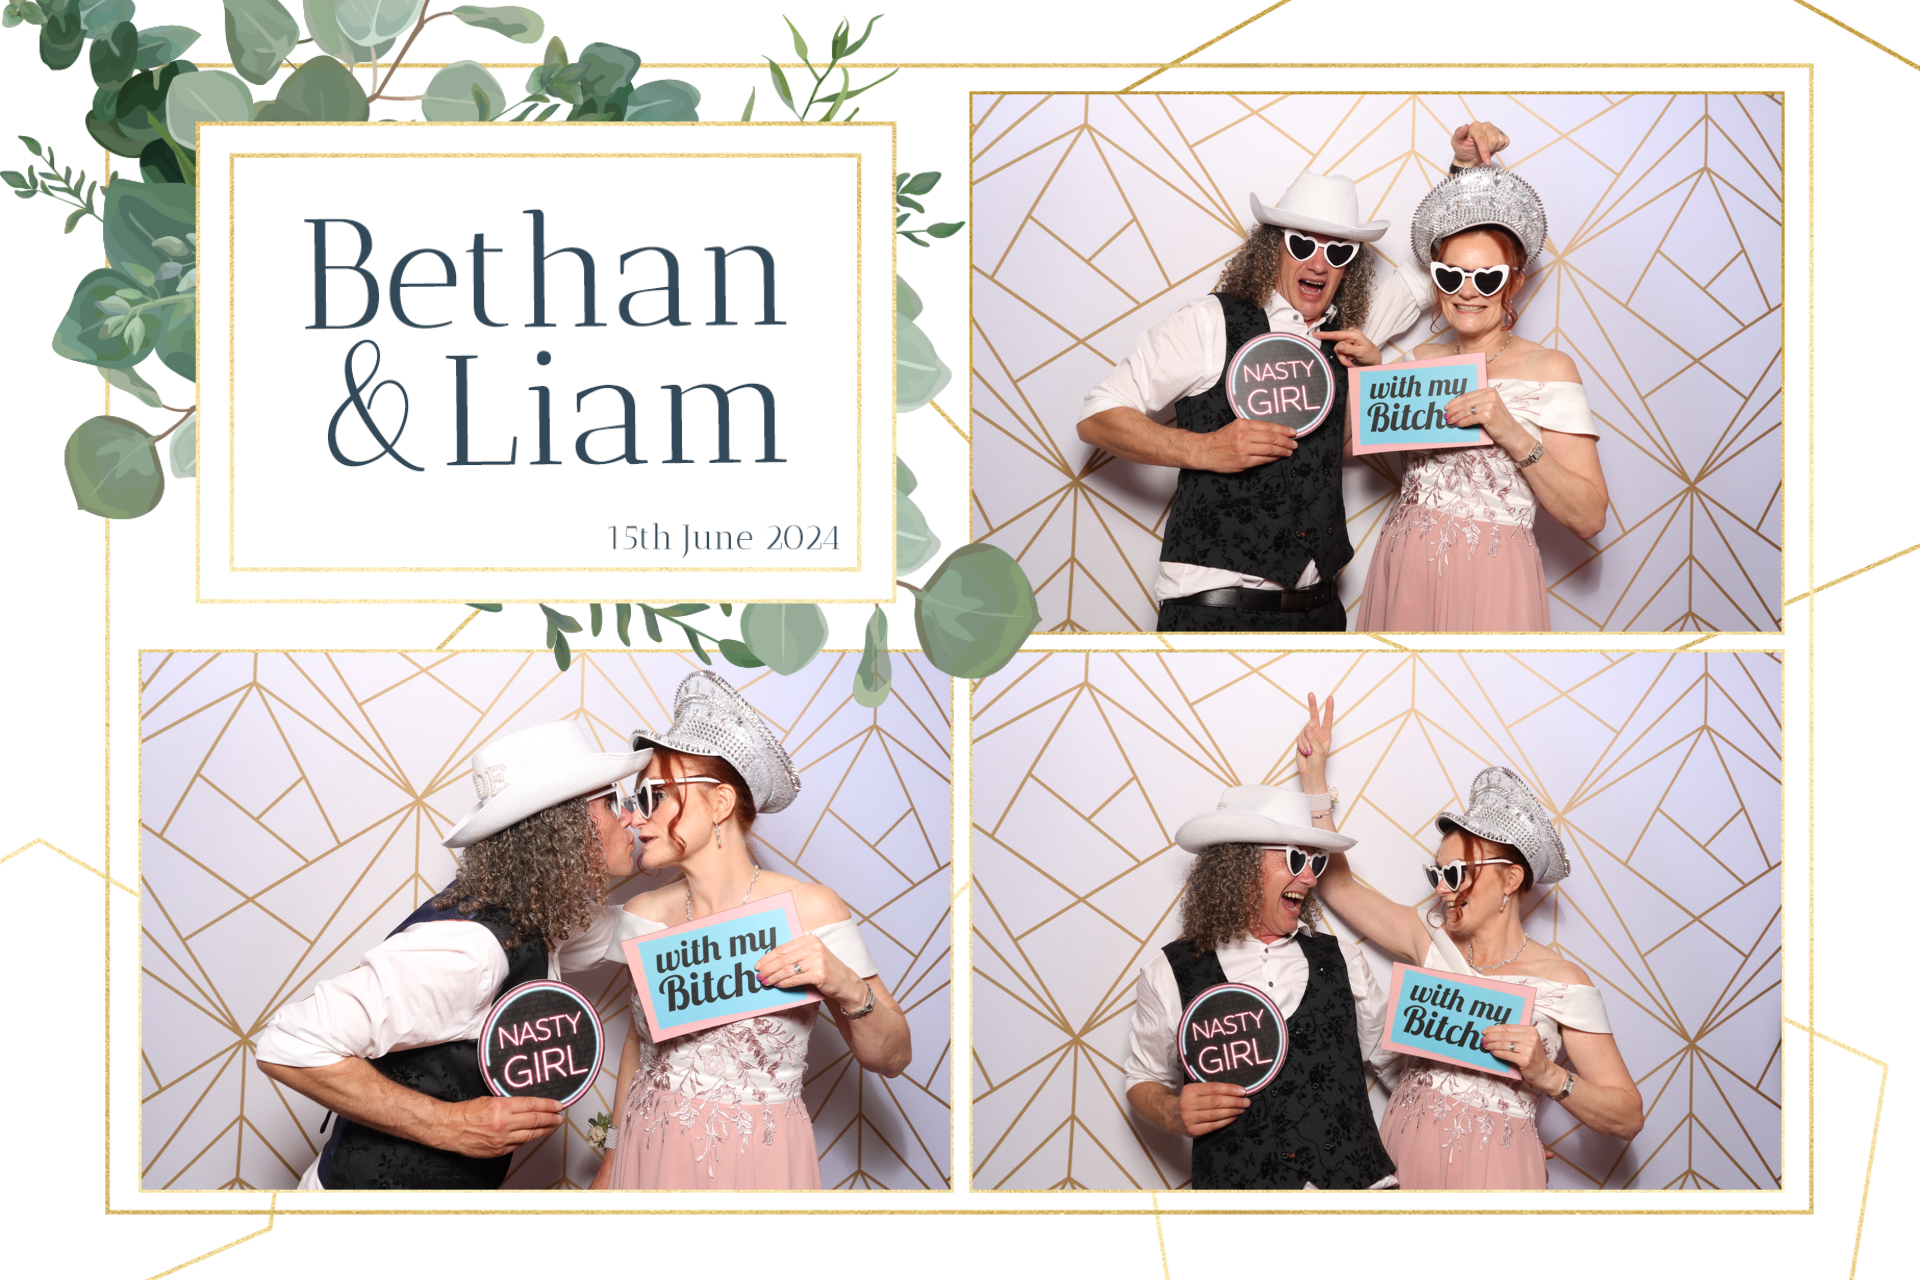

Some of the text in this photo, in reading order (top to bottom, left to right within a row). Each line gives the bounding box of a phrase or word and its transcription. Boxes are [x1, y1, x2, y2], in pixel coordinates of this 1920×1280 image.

[1242, 358, 1315, 383] NASTY
[1369, 375, 1468, 400] with my
[1247, 385, 1321, 415] GIRL
[1367, 401, 1456, 433] Bitch
[655, 926, 777, 974] with my
[659, 962, 775, 1012] Bitch
[1409, 984, 1513, 1026] with my
[498, 1010, 582, 1050] NASTY
[1191, 1008, 1265, 1042] NASTY
[1403, 1005, 1490, 1054] Bitch
[503, 1045, 589, 1088] GIRL
[1198, 1039, 1273, 1075] GIRL
